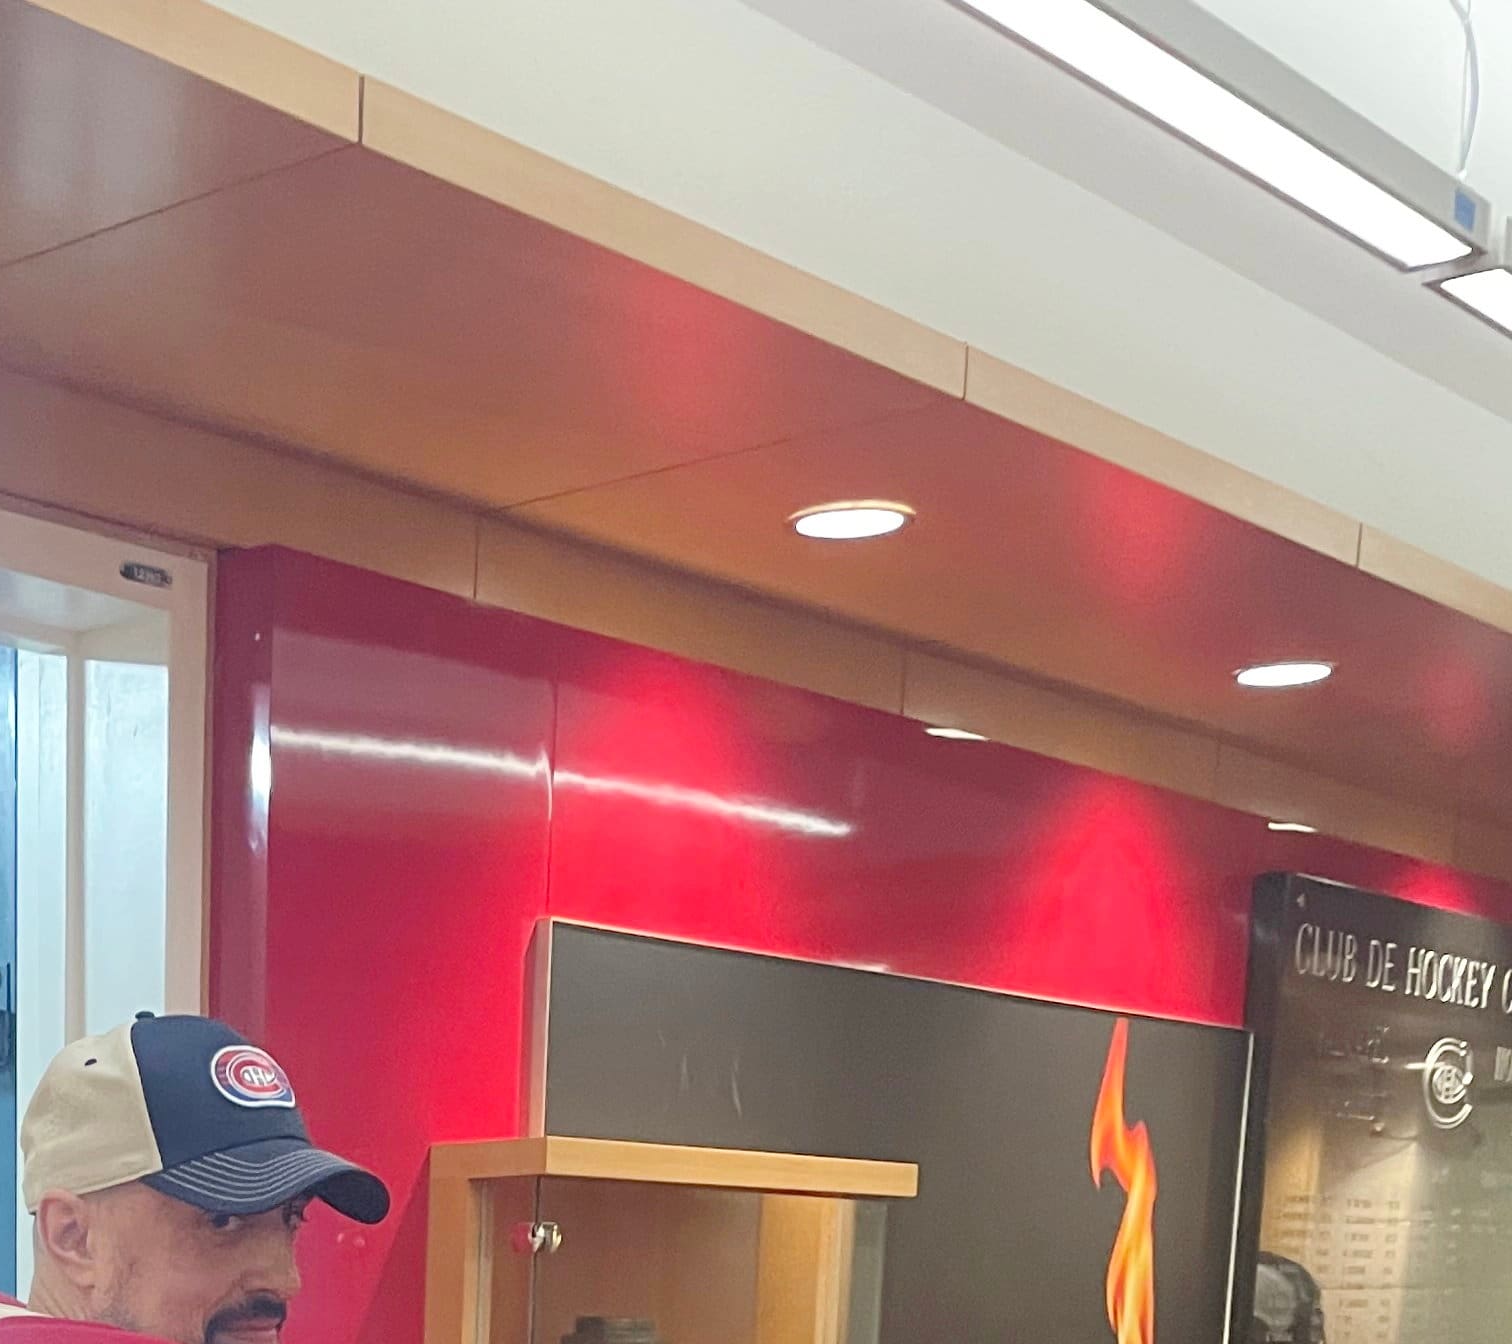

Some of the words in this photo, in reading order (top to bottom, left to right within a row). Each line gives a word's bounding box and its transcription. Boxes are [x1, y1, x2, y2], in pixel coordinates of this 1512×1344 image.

[1296, 923, 1357, 983] CLUB
[1366, 939, 1398, 991] DE
[1405, 947, 1496, 1009] HOCKEY
